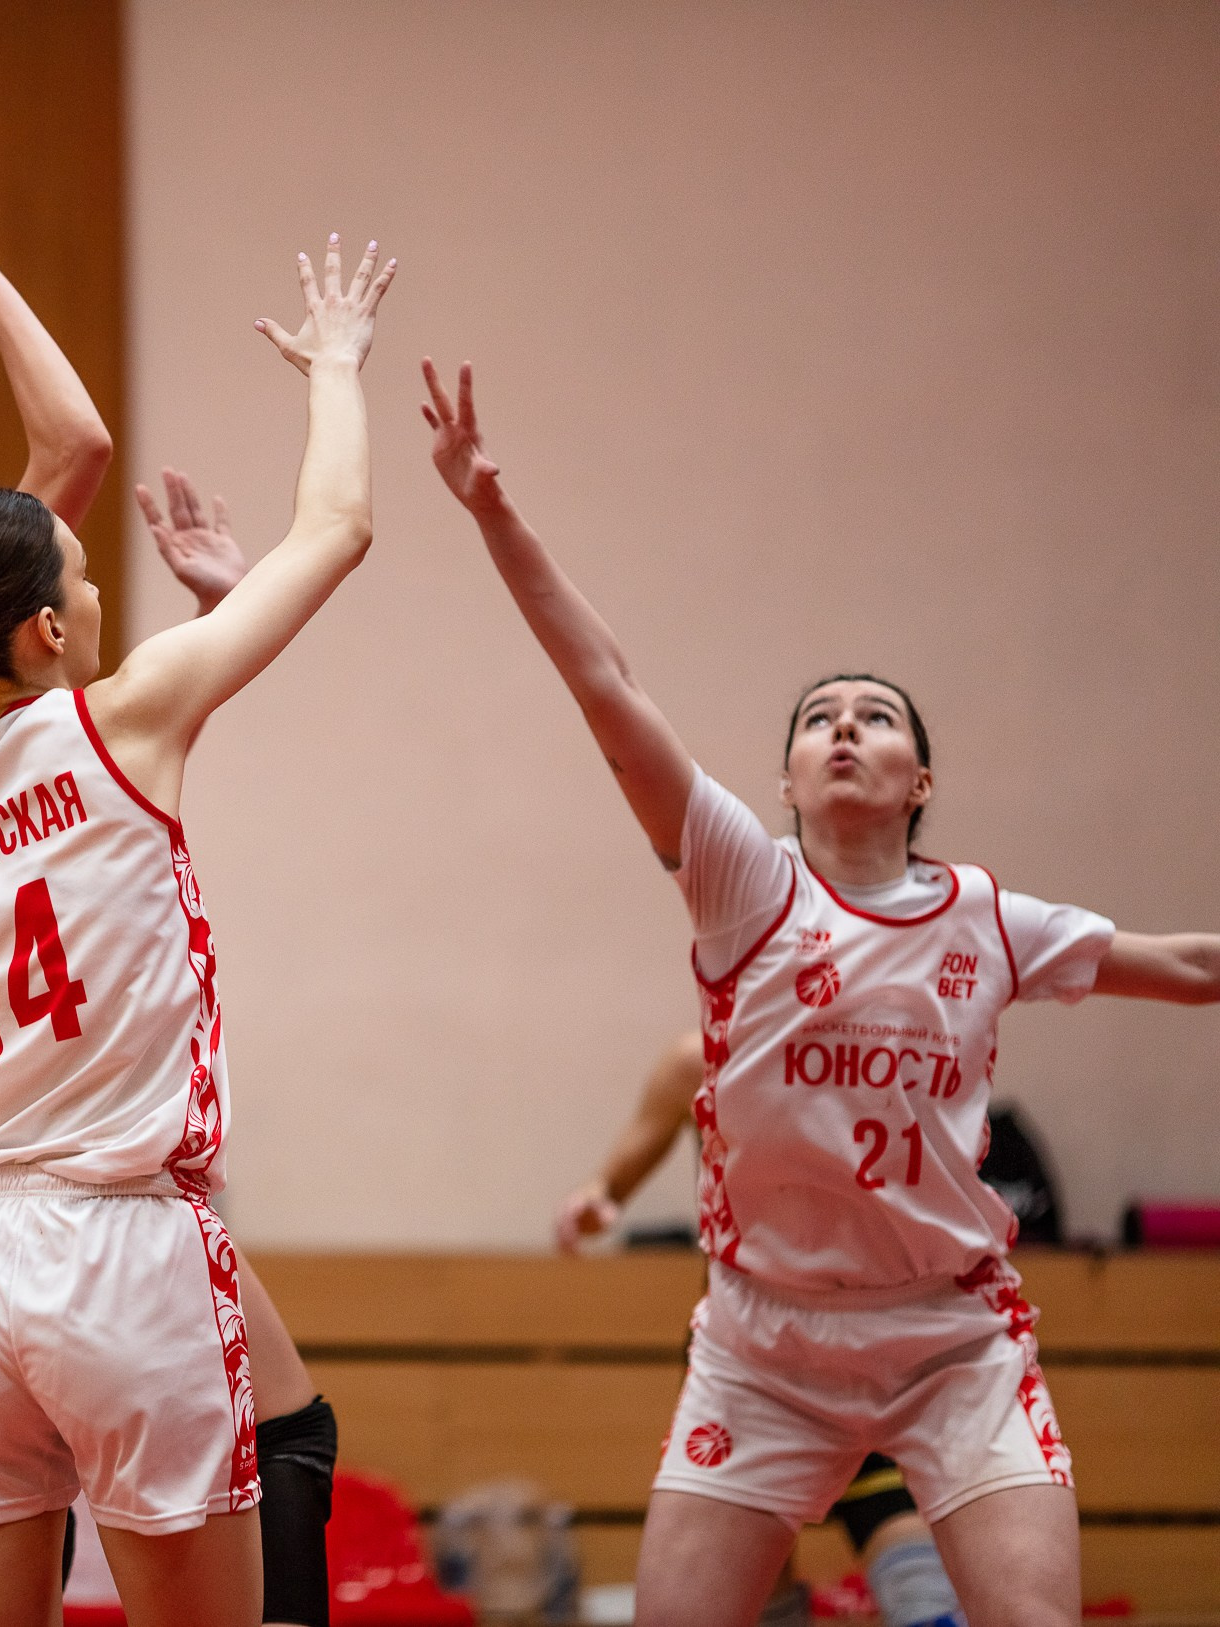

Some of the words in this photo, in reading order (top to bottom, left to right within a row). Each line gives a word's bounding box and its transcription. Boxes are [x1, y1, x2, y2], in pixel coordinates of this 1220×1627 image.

[940, 951, 978, 975] FON
[938, 977, 979, 1000] BET
[784, 1042, 962, 1099] ЮНОСТЬ
[853, 1118, 923, 1190] 21
